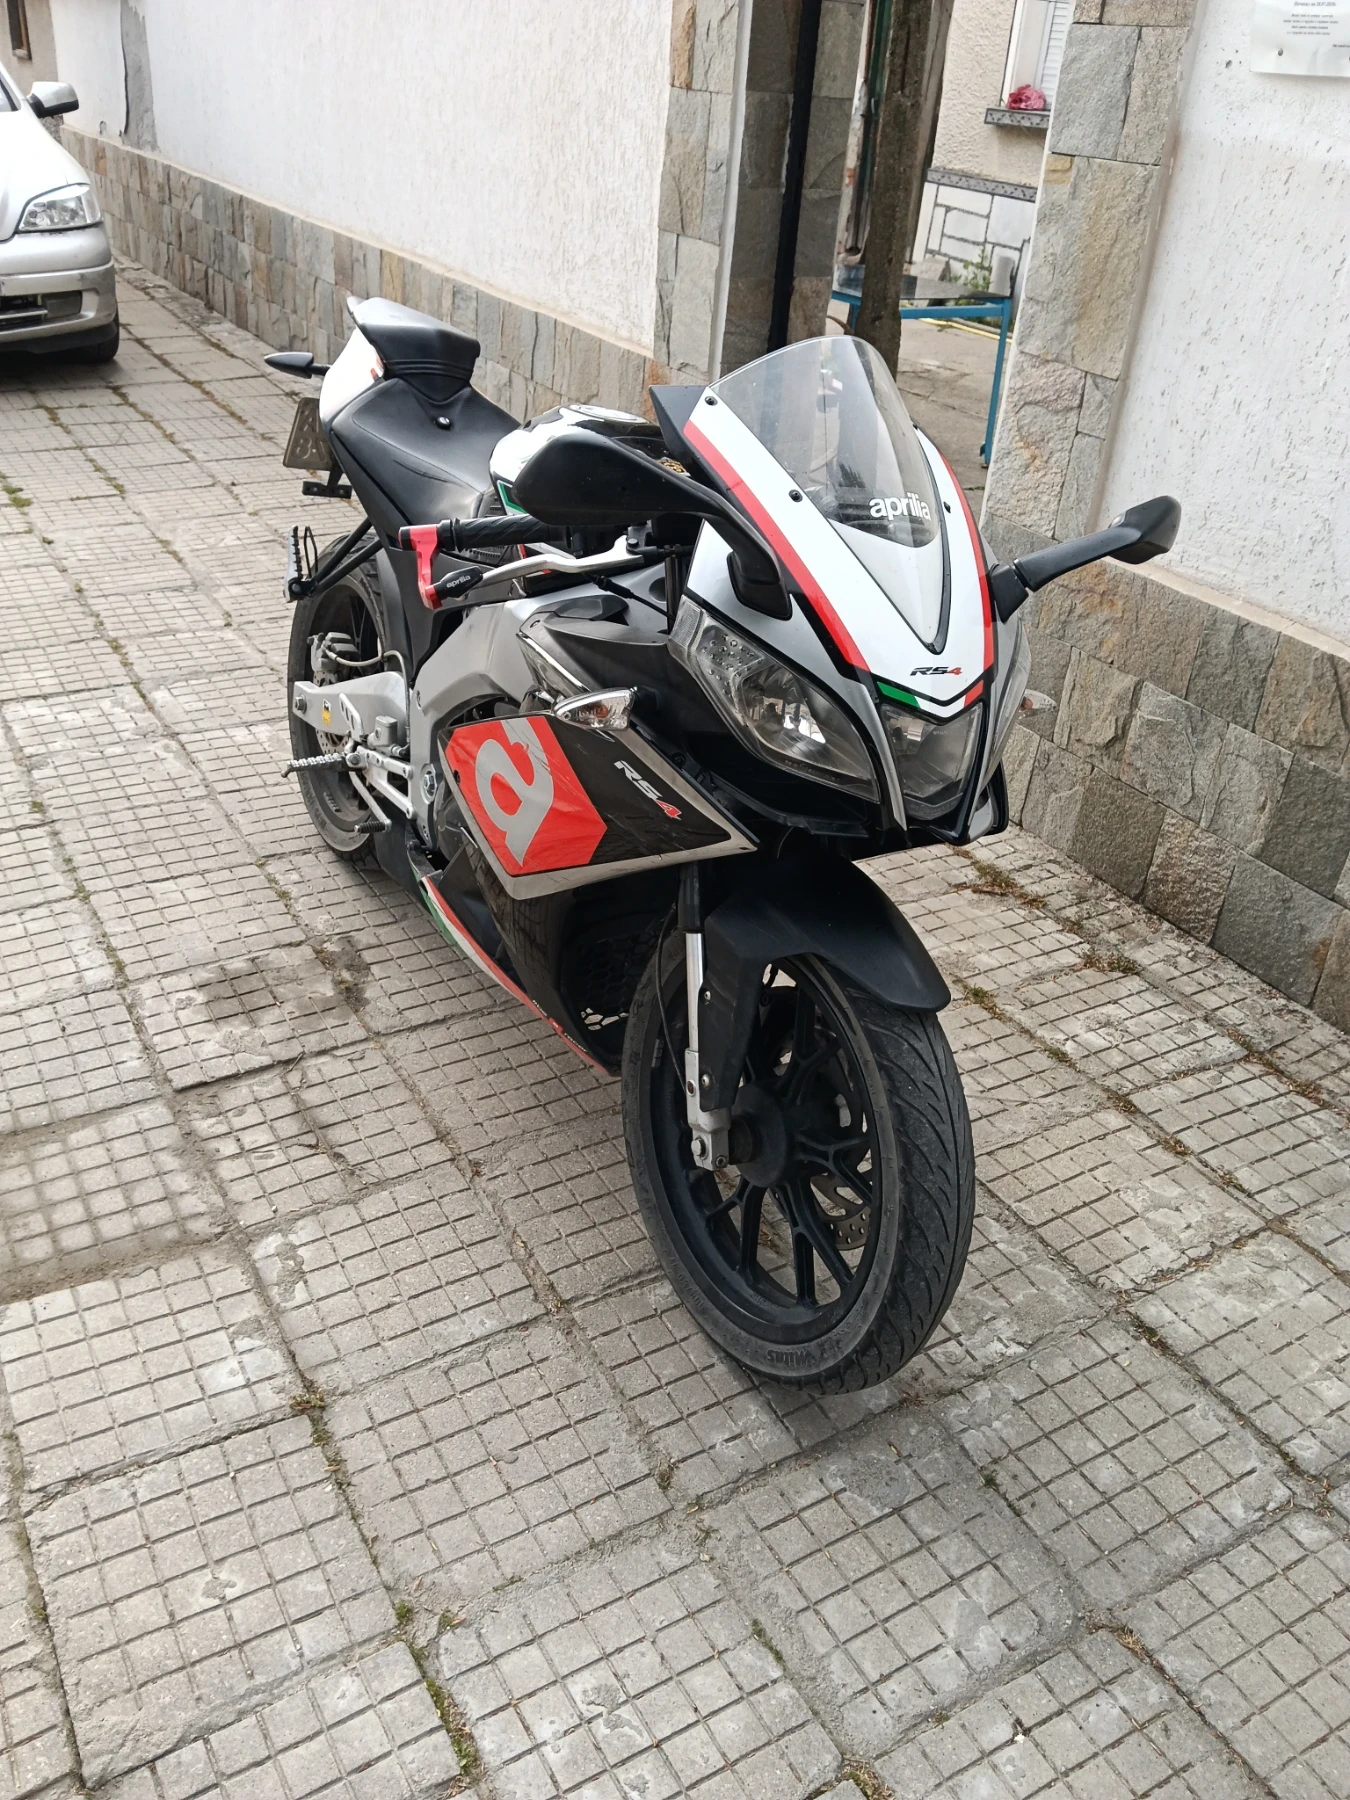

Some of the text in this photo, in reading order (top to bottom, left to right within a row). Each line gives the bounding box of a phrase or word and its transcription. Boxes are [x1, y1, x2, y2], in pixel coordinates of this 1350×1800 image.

[869, 491, 931, 521] aprilia
[446, 575, 471, 588] aprilia
[909, 666, 962, 676] RS4
[613, 760, 682, 820] RS4
